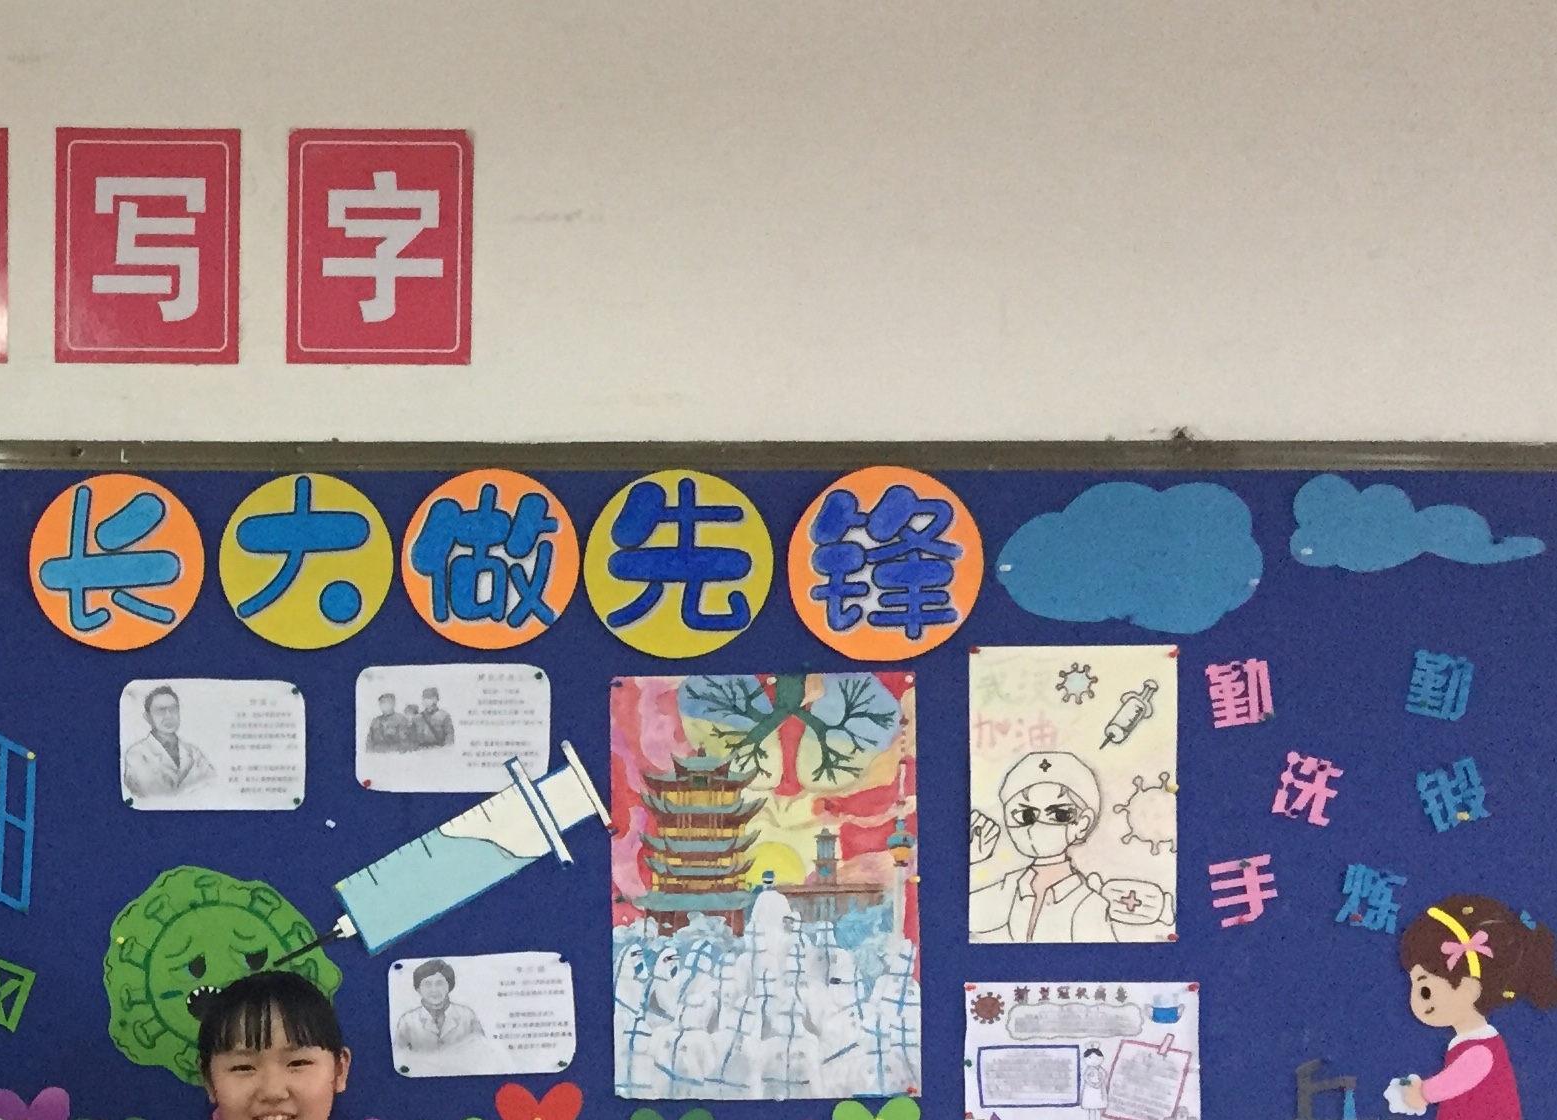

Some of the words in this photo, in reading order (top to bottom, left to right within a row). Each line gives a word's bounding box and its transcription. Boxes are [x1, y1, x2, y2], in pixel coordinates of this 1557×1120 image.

[39, 474, 964, 639] 长大做先锋
